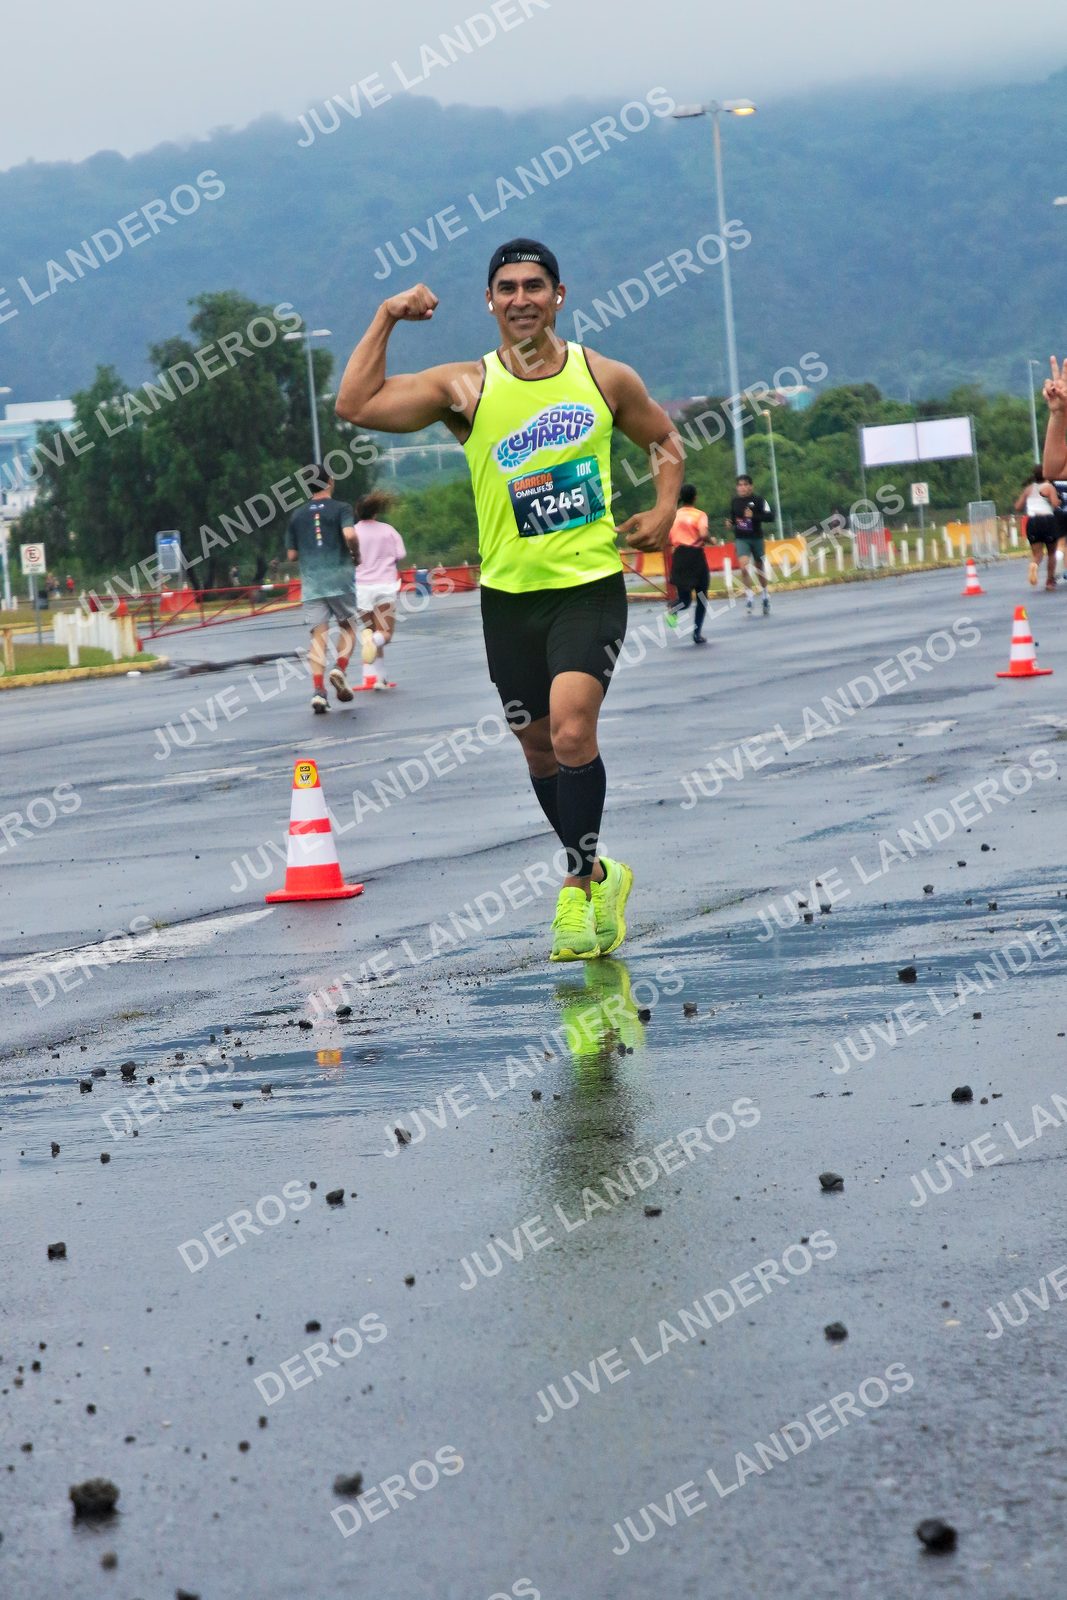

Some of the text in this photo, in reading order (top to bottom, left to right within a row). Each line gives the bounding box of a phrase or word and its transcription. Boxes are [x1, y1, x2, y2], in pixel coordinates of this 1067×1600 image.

[537, 410, 595, 427] SOMOS
[508, 424, 581, 452] CHAPU
[575, 462, 592, 477] 10K
[513, 472, 552, 492] CARRERA
[530, 487, 585, 517] 1245
